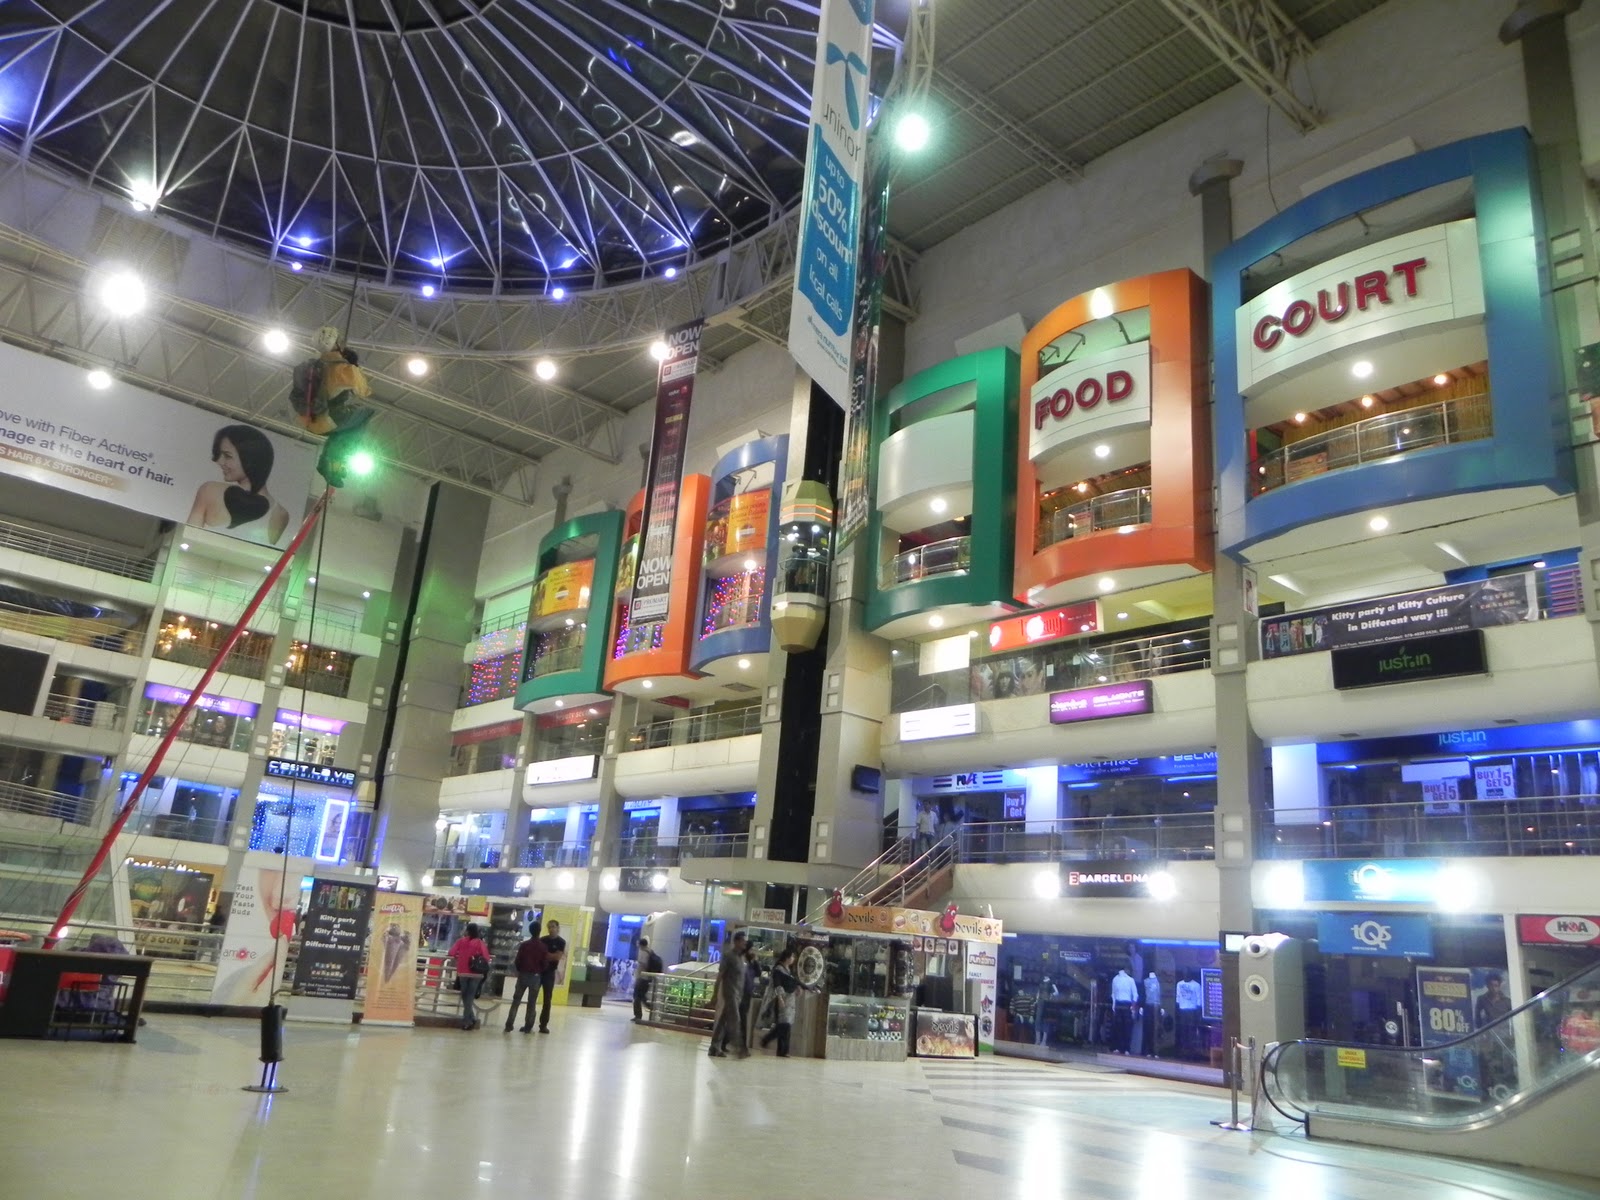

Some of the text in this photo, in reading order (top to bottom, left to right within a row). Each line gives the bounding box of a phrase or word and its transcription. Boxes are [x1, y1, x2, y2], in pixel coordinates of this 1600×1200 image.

[1253, 257, 1427, 351] COURT
[669, 326, 702, 345] NOW
[668, 340, 699, 360] OPEN
[1034, 370, 1134, 430] FOOD
[26, 417, 56, 434] with
[59, 425, 96, 446] Fiber
[7, 448, 34, 462] HAIR
[40, 438, 56, 450] at
[58, 442, 82, 459] the
[86, 450, 125, 472] heart
[128, 464, 145, 476] of
[146, 468, 174, 486] hair.
[640, 556, 671, 575] NOW
[636, 572, 670, 590] OPEN
[1332, 593, 1464, 622] Kitty party at Kitty Culture
[1347, 623, 1358, 632] in
[1360, 616, 1408, 630] Different
[1411, 612, 1433, 622] way
[1477, 770, 1495, 780] BUY
[1503, 772, 1511, 786] 5
[1424, 784, 1441, 793] BUY
[1448, 786, 1456, 800] 5
[1006, 797, 1019, 807] Buy
[235, 892, 254, 900] Your
[233, 900, 255, 908] Taste
[320, 914, 336, 922] Kitty
[305, 940, 336, 948] Different
[1456, 1022, 1470, 1032] OFF
